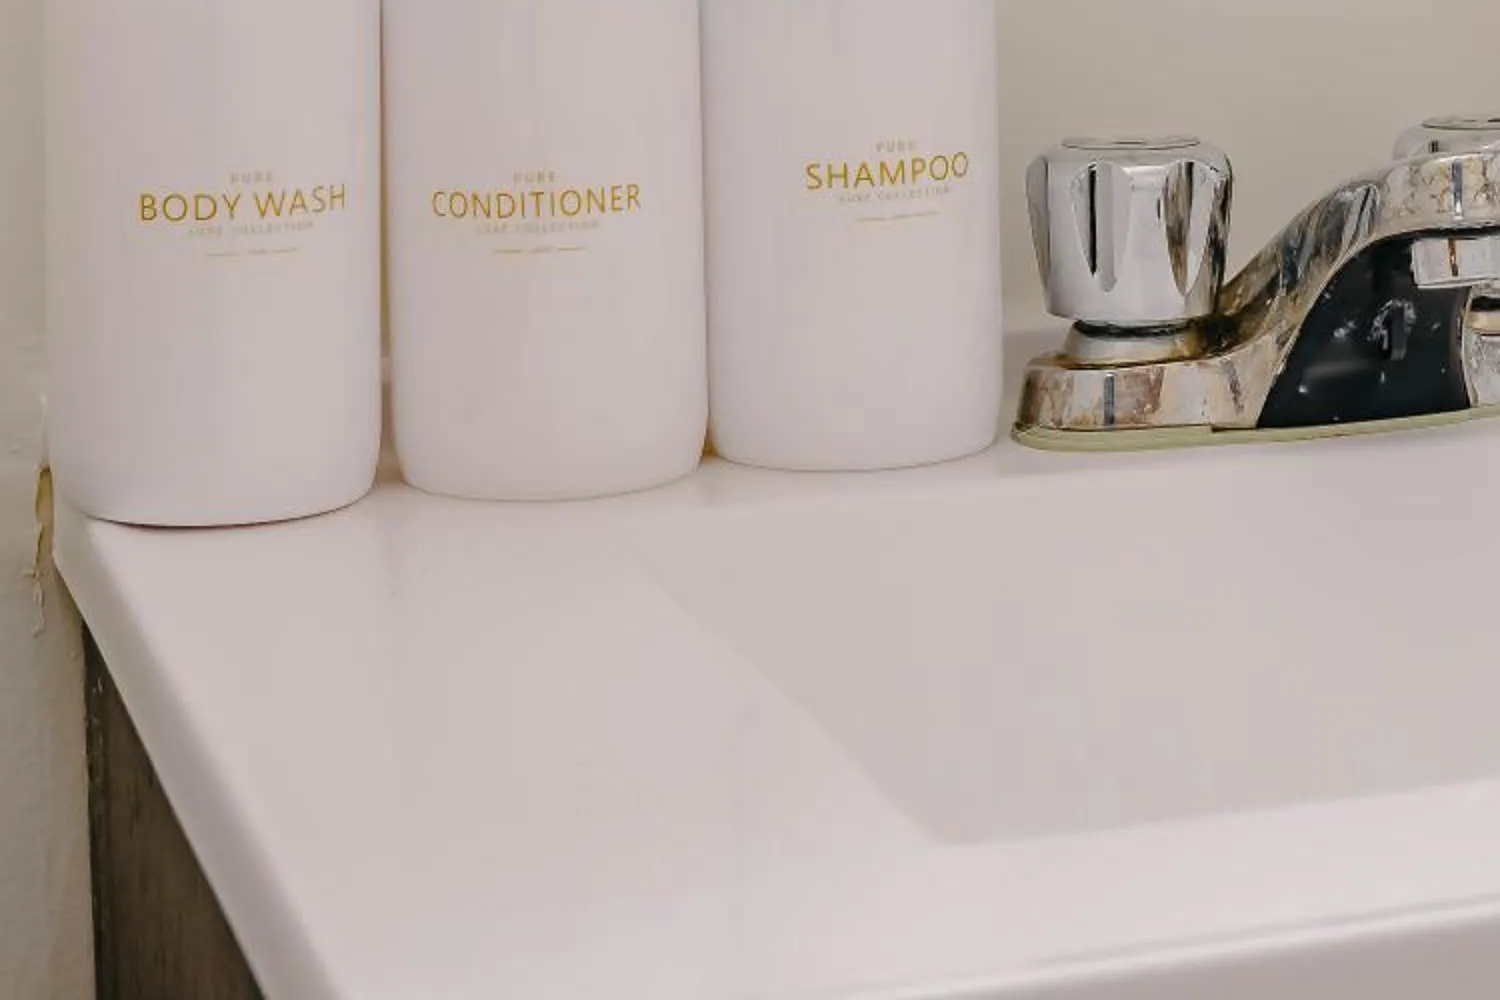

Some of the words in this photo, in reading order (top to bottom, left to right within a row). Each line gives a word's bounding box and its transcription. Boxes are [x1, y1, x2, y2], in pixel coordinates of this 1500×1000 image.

[805, 151, 969, 190] SHAMPOO
[139, 192, 243, 222] BODY
[252, 183, 346, 219] WASH
[431, 183, 642, 220] CONDITIONER
